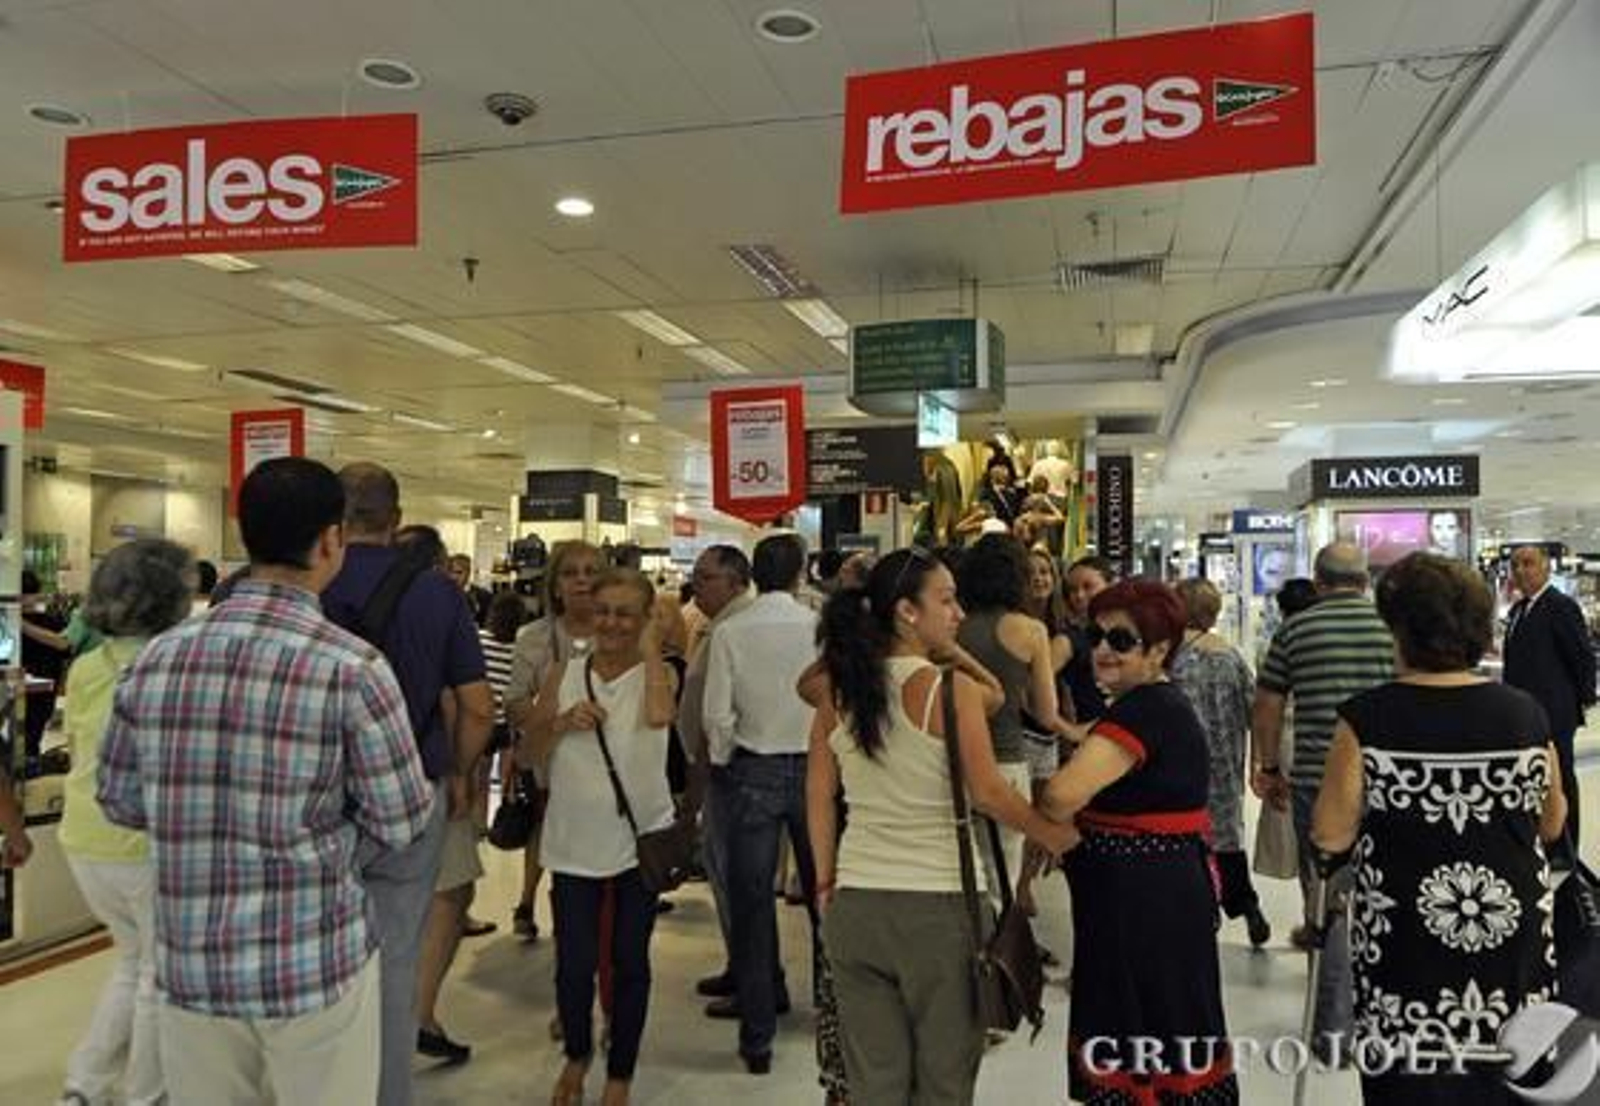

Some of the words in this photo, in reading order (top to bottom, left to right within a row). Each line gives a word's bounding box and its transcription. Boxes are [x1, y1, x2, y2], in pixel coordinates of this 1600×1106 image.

[866, 69, 1203, 172] rebajas
[80, 139, 324, 232] sales
[1328, 462, 1465, 489] LANCÔME
